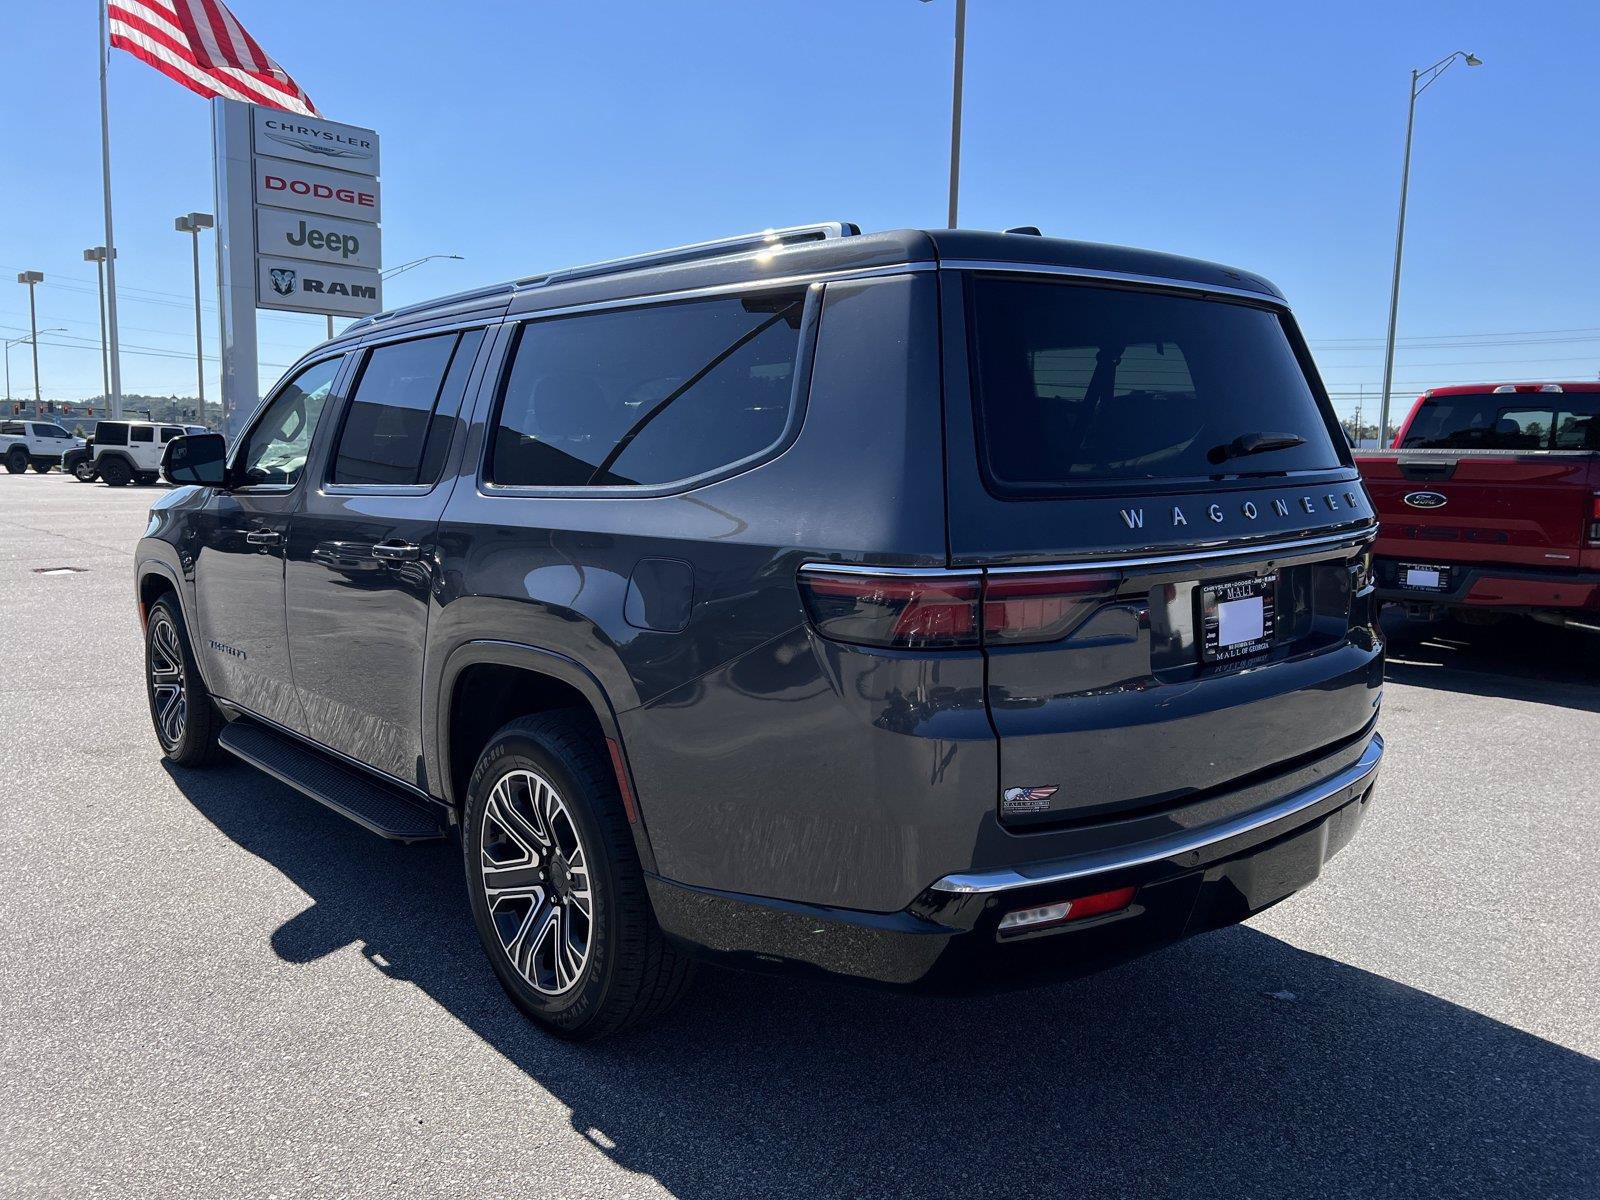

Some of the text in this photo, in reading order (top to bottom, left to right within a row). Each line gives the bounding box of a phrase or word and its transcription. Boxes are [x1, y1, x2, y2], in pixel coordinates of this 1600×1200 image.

[265, 120, 371, 149] CHRYSLER
[265, 176, 375, 207] DODGE
[286, 220, 360, 258] Jeep
[303, 278, 376, 299] RAM
[1120, 492, 1359, 529] WAGONEER
[1216, 649, 1241, 661] MALL
